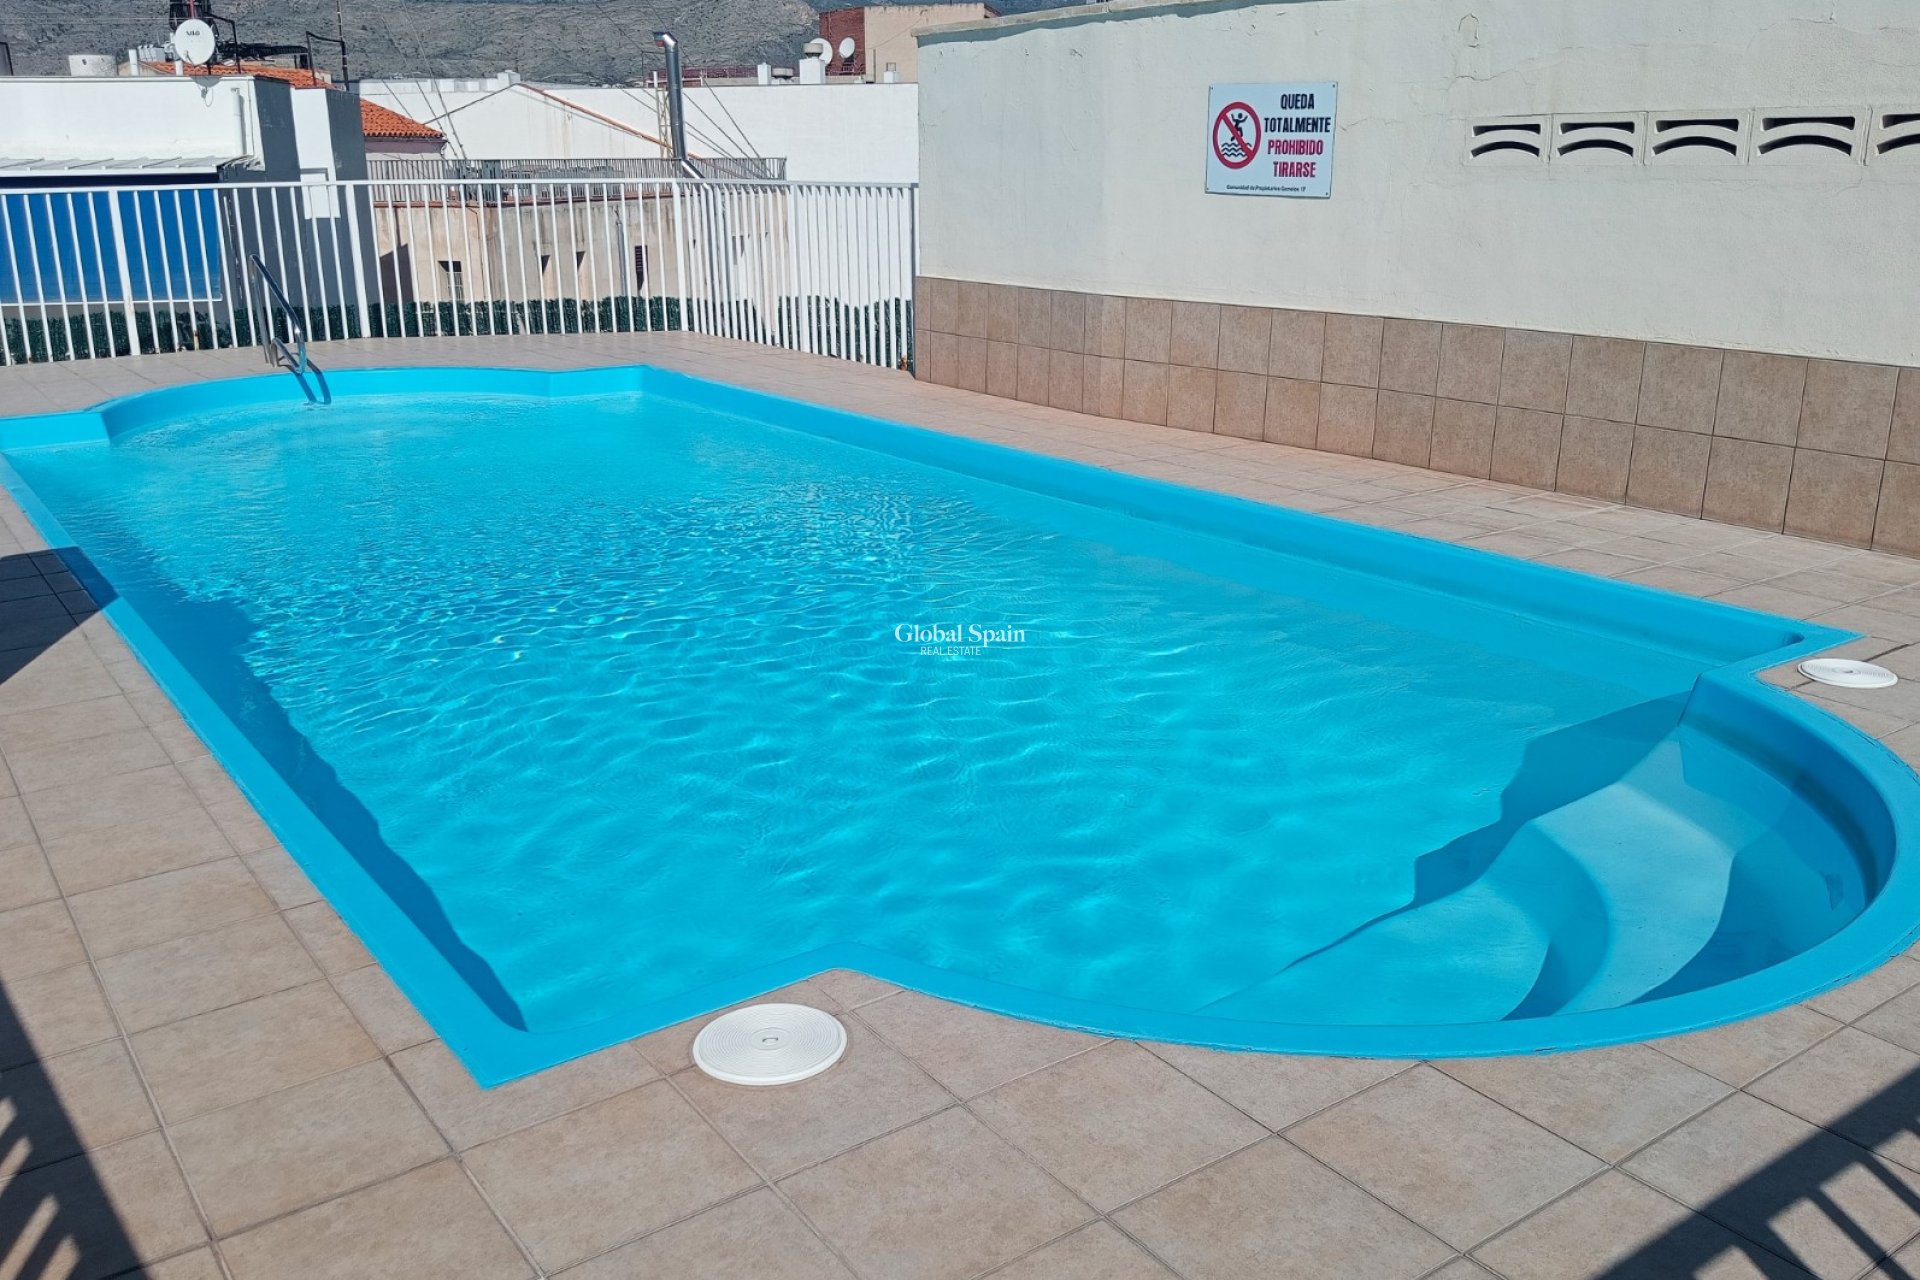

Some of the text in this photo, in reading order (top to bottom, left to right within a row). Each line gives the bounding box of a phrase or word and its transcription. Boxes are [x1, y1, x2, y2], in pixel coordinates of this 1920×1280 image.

[1280, 93, 1315, 110] QUEDA
[1264, 117, 1332, 133] TOTALMENTE
[1267, 139, 1324, 156] PROHIBIDO
[1273, 161, 1316, 178] TIRARSE
